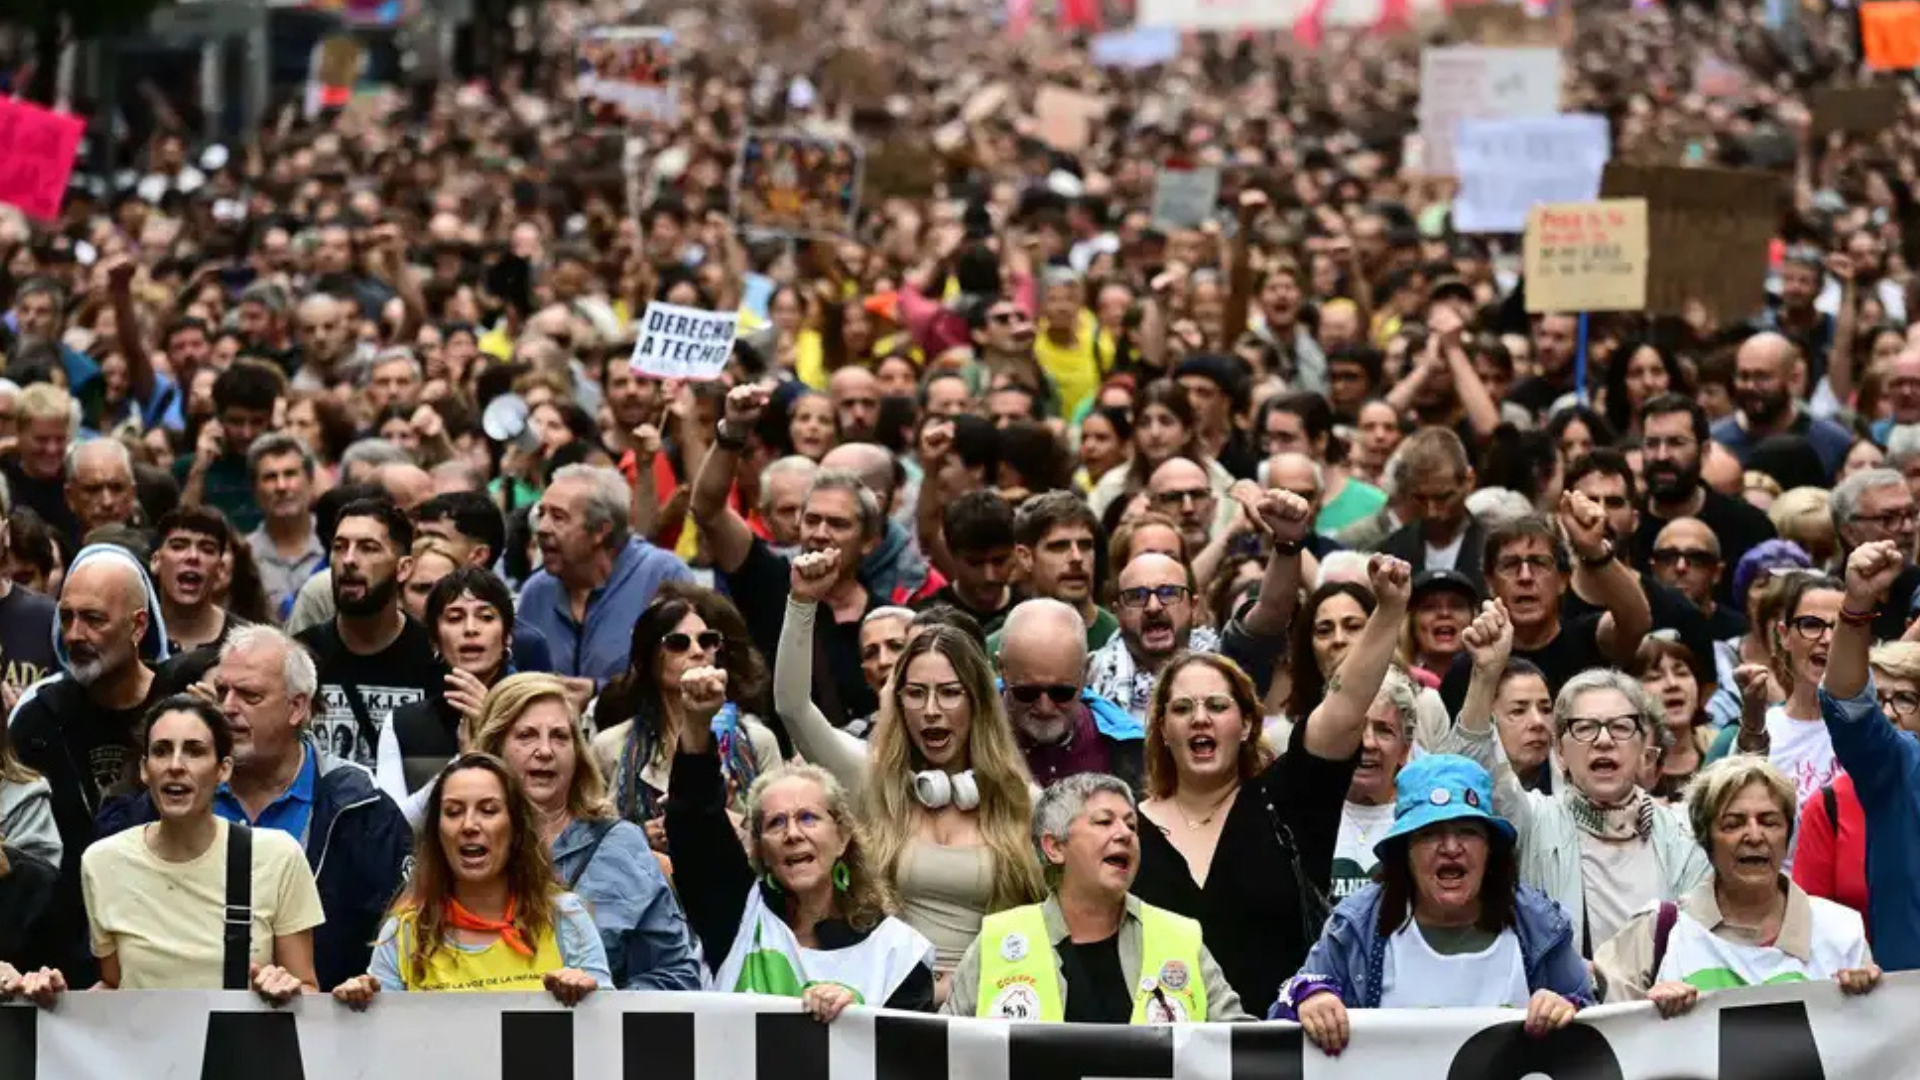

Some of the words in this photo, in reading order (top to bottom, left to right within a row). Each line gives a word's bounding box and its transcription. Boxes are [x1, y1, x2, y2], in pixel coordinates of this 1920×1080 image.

[648, 310, 735, 341] DERECHO
[641, 336, 654, 355] A
[660, 339, 727, 364] TECHO
[466, 979, 484, 989] VOZ
[500, 976, 512, 984] LA
